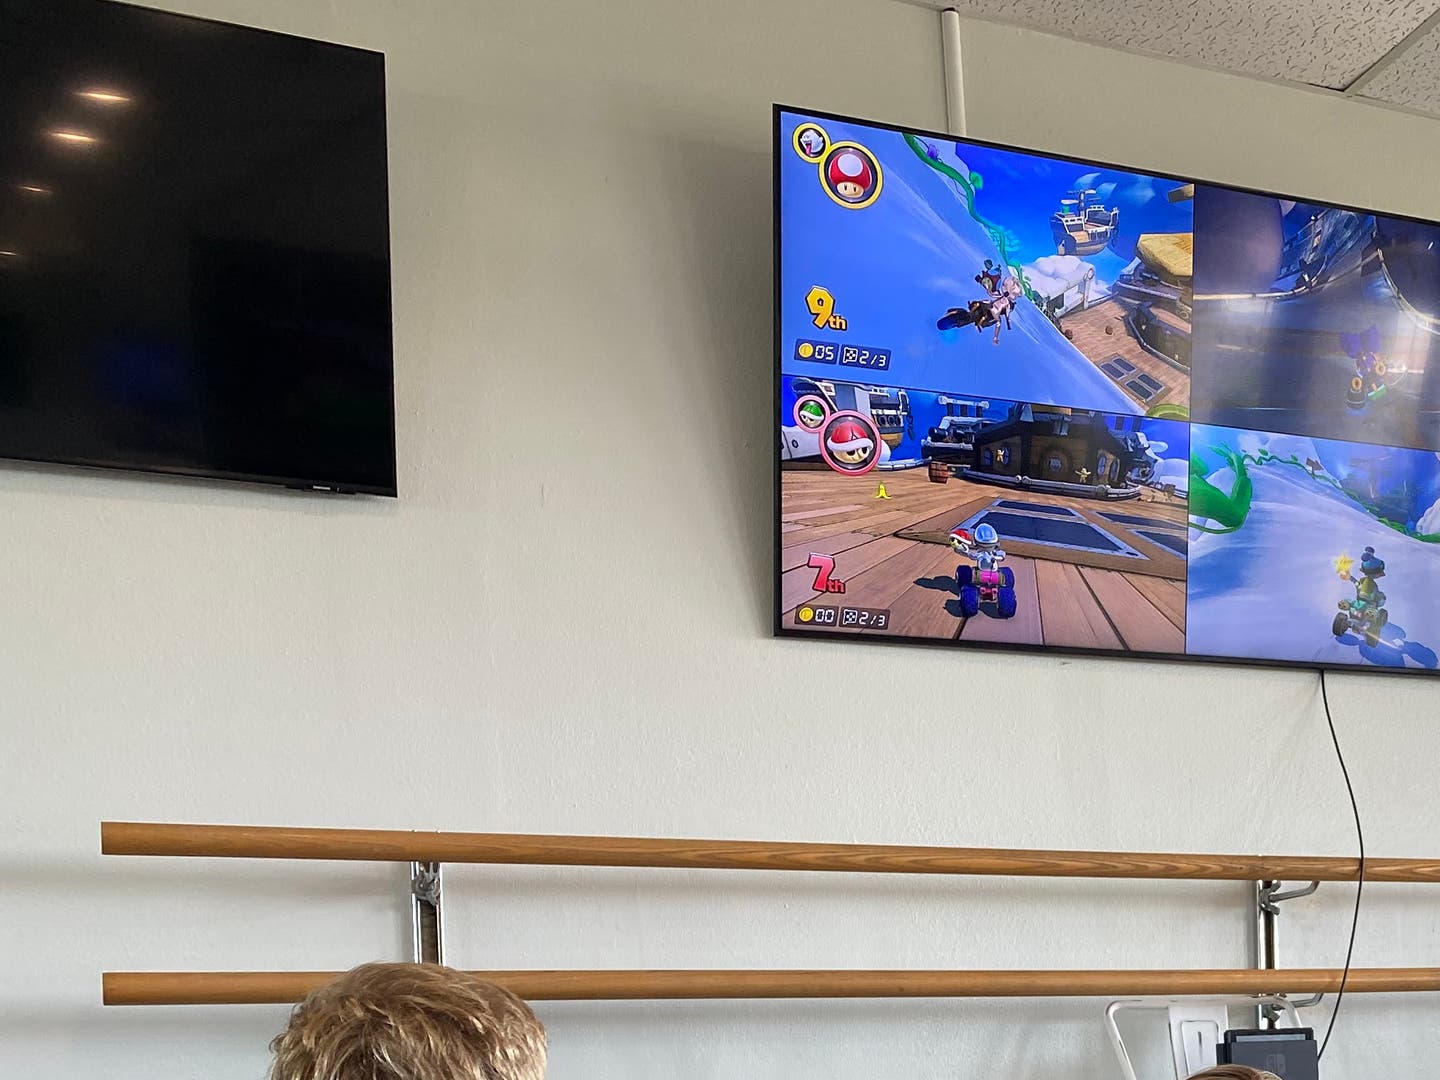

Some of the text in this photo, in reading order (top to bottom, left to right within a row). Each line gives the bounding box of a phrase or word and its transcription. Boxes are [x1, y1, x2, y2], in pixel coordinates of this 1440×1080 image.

[805, 285, 847, 331] 9th
[815, 345, 887, 367] 05 2/3
[807, 552, 846, 594] 7th
[815, 608, 886, 626] 00 2/3
